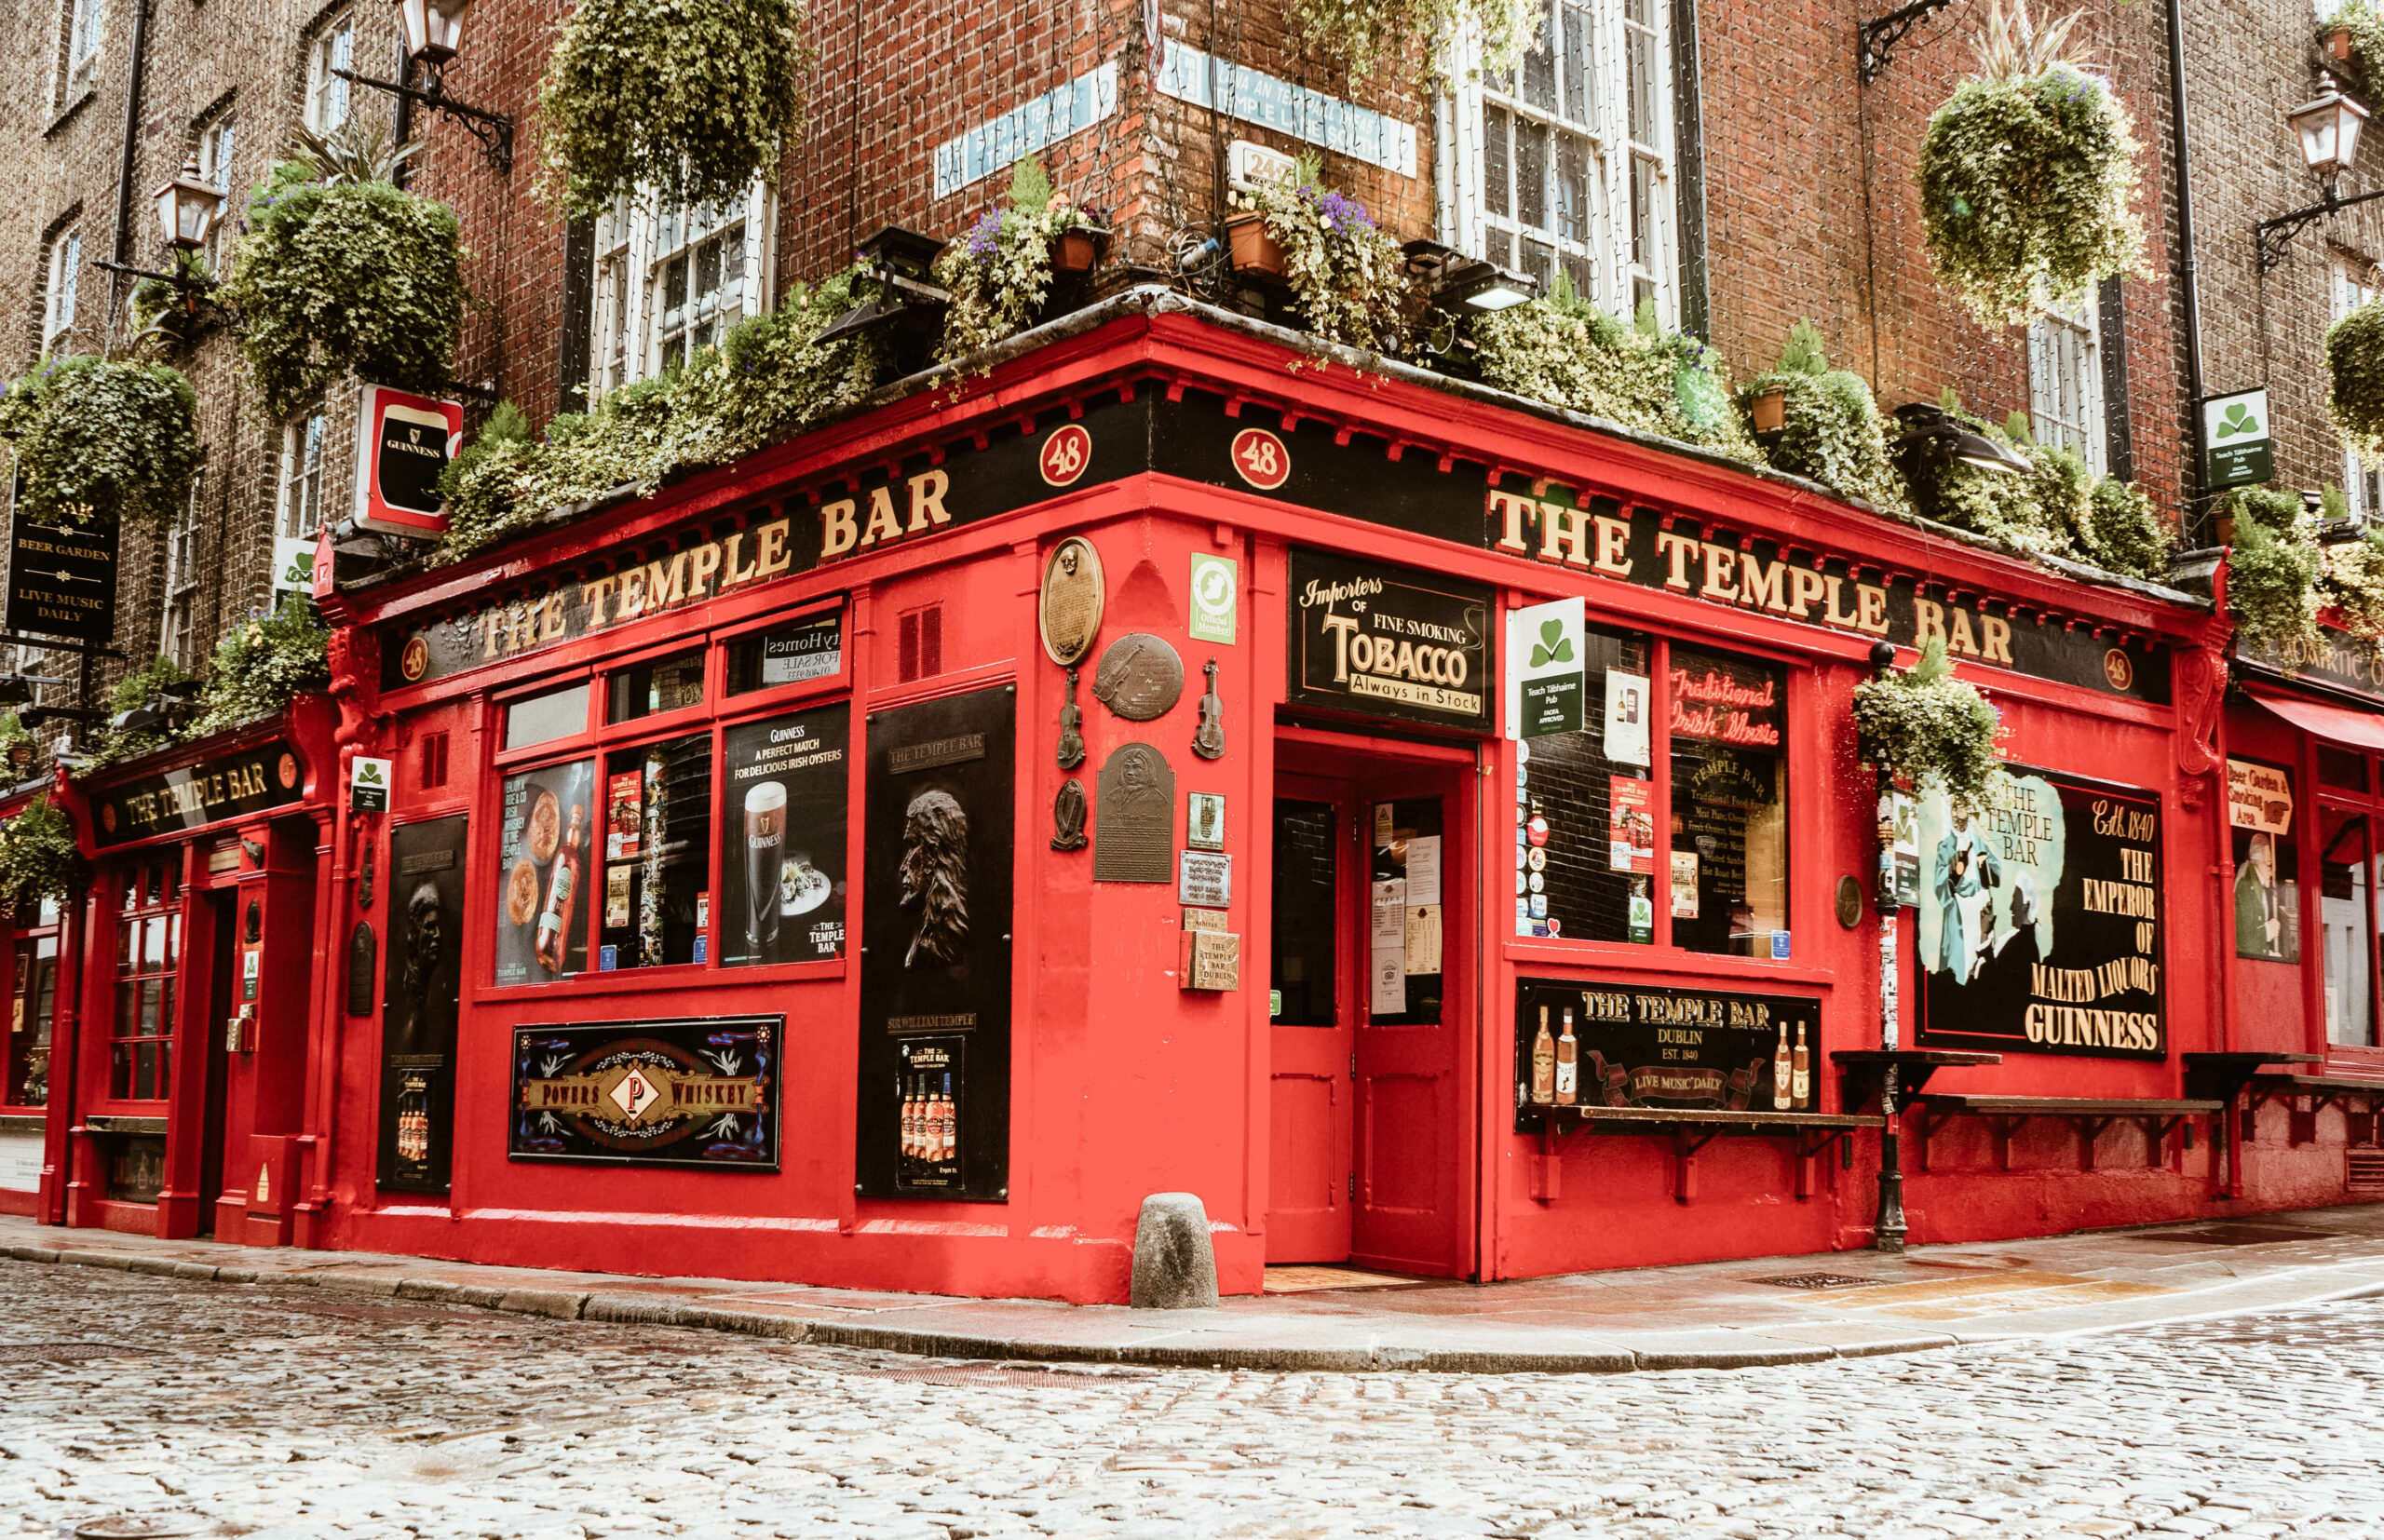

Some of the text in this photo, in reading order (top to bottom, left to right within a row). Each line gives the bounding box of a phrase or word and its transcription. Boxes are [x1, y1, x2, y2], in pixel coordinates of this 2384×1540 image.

[1100, 79, 1110, 104] 2
[1253, 79, 1272, 98] AN
[387, 439, 440, 459] GUINNESS
[1049, 437, 1080, 477] 48
[1241, 437, 1277, 475] 48
[19, 538, 111, 561] BEER GARDEN
[483, 468, 952, 659] THE TEMPLE BAR
[1489, 489, 2014, 667] THE TEMPLE BAR
[19, 588, 104, 610] LIVE MUSIC
[1299, 576, 1383, 614] Importers
[1352, 600, 1367, 613] OF
[38, 607, 84, 622] DAILY
[1374, 614, 1468, 645] FINE SMOKING
[405, 643, 425, 676] 48
[1322, 614, 1469, 688] TOBACCO
[2107, 654, 2126, 681] 48
[1353, 674, 1479, 711] Always in Stock
[1527, 686, 1545, 696] Teach
[1546, 695, 1558, 705] Pub
[1672, 669, 1773, 707] Traditional
[1538, 714, 1564, 724] APPROVED
[1671, 700, 1780, 745] Irish Music
[771, 725, 805, 743] GUINNESS
[755, 737, 820, 761] A PERFECT MATCH
[891, 749, 910, 764] THE
[914, 738, 956, 759] TEMPLE
[959, 734, 982, 751] BAR
[735, 749, 842, 780] FOR DELICIOUS IRISH OYSTERS
[1691, 760, 1766, 798] TEMPLE BAR
[2248, 769, 2279, 791] Garden
[127, 792, 158, 825] THE
[159, 774, 225, 817] TEMPLE
[226, 762, 267, 801] BAR
[1987, 807, 2053, 842] TEMPLE
[2128, 810, 2155, 843] 1840
[2236, 806, 2256, 827] Area
[749, 833, 781, 849] GUINNESS
[2003, 836, 2039, 867] BAR
[2120, 847, 2154, 884] THE
[2082, 877, 2156, 920] EMPEROR
[809, 927, 845, 944] TEMPLE
[820, 922, 834, 932] THE
[2136, 922, 2154, 955] OF
[818, 941, 836, 953] BAR
[1204, 952, 1233, 961] TEMPLE
[1204, 971, 1234, 979] DUBLIN
[2030, 955, 2159, 1004] MALTED LIQUORS
[940, 1013, 974, 1027] TEMPLE
[1582, 992, 1771, 1031] THE TEMPLE BAR
[1658, 1028, 1703, 1045] DUBLIN
[2025, 1003, 2159, 1051] GUINNESS
[910, 1053, 950, 1064] TEMPLE BAR
[1662, 1049, 1699, 1060] EST. 1840
[543, 1076, 747, 1111] POWERS P WHISKEY
[1634, 1075, 1723, 1091] LIVE MUSIC DAILY
